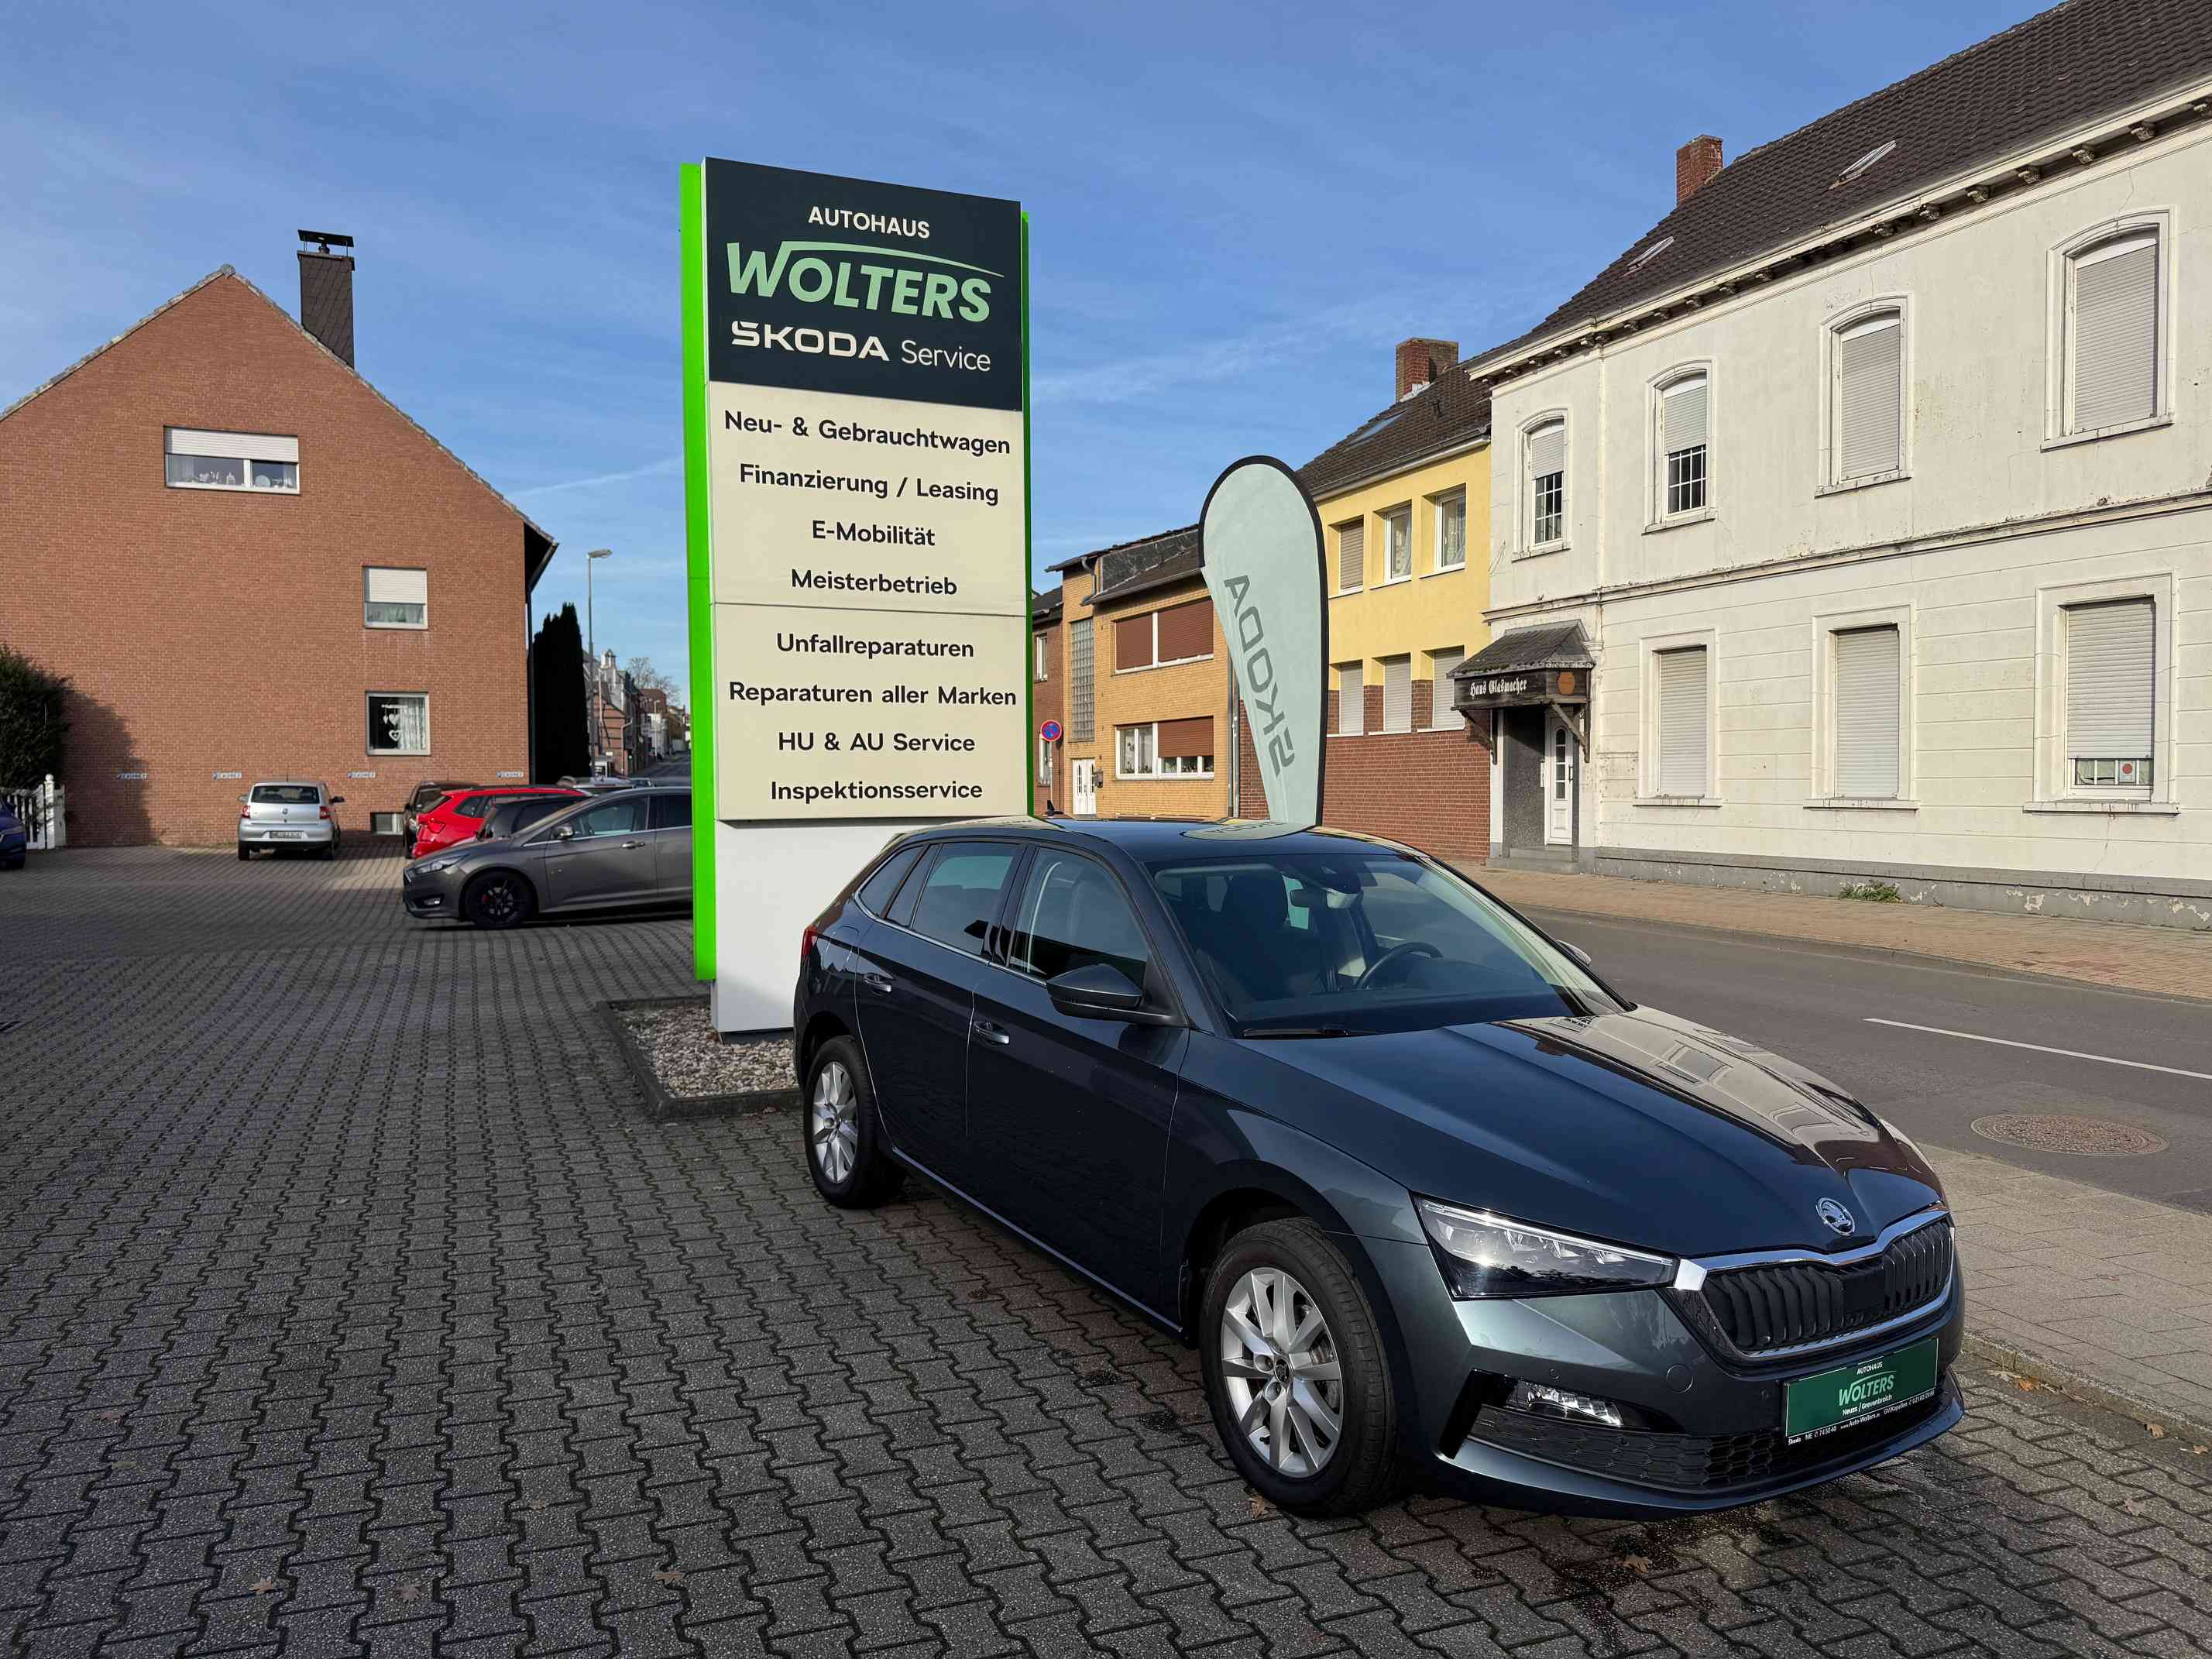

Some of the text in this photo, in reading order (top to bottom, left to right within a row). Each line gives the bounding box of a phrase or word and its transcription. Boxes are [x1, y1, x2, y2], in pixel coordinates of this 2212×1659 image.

[808, 206, 930, 239] AUTOHAUS
[726, 241, 993, 322] WOLTERS
[901, 339, 991, 372] Service
[724, 410, 1011, 457] Neu- & Gebrauchtwagen
[740, 462, 999, 507] Finanzierung / Leasing
[812, 520, 936, 547] E-Mobilität
[791, 568, 958, 596] Meisterbetrieb
[776, 632, 975, 660] Unfallreparaturen
[729, 681, 1017, 706] Reparaturen aller Marken
[778, 732, 976, 752] HU & AU Service
[771, 780, 984, 805] Inspektionsservice
[1856, 1362, 1883, 1376] AUTOHAUS
[1839, 1371, 1895, 1407] WOLTERS
